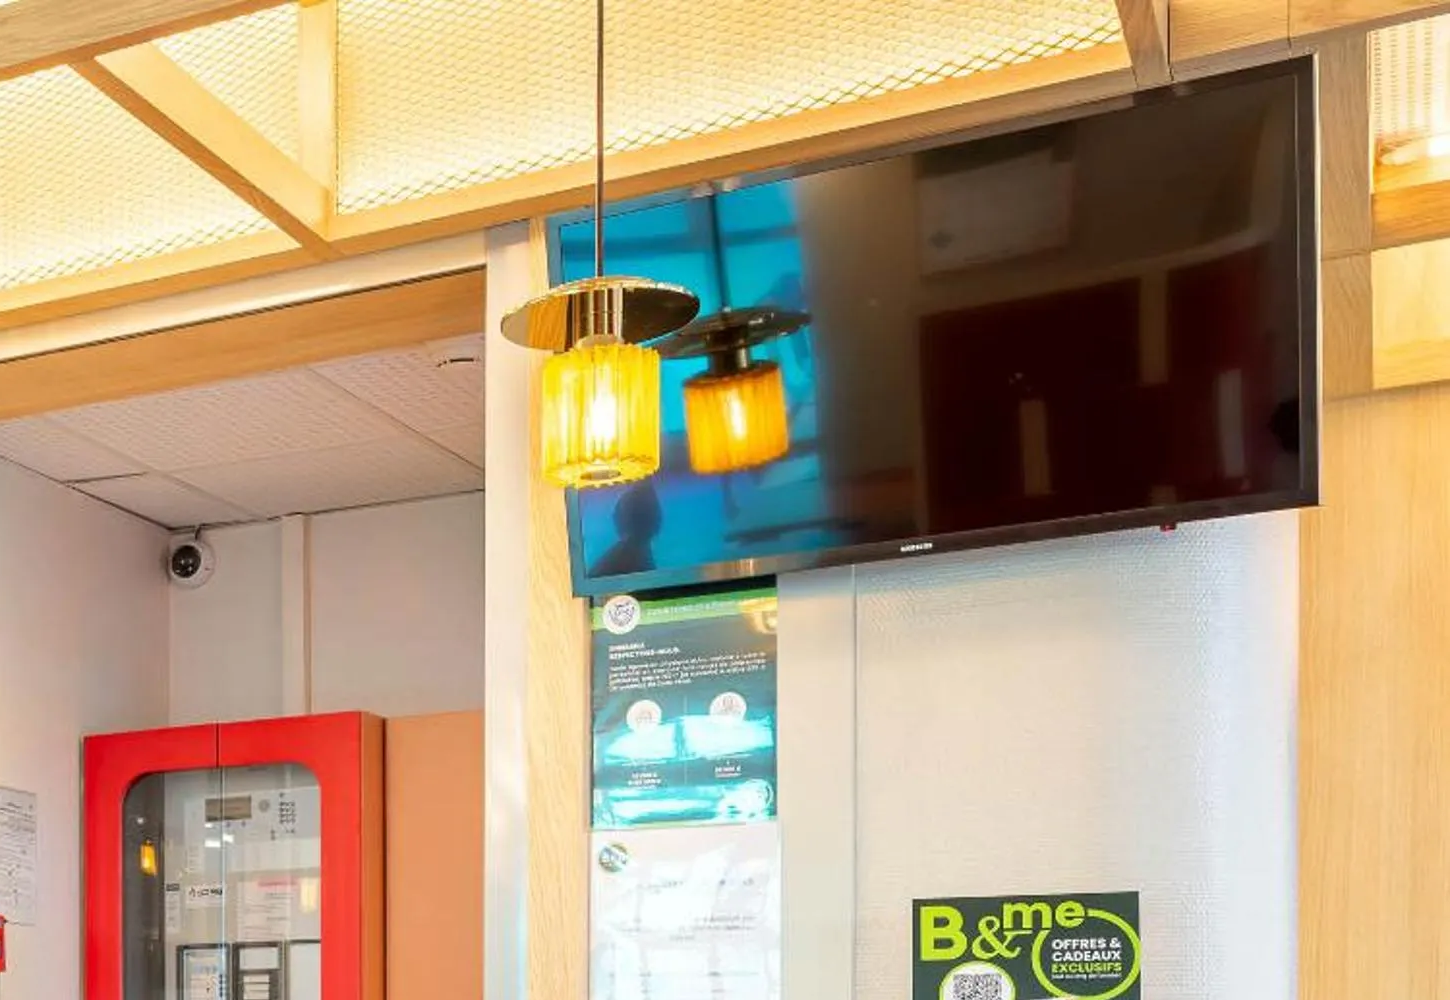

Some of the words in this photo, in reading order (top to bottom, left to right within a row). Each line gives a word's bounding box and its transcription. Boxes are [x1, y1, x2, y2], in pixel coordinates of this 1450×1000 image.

[1051, 938, 1107, 950] OFFRES
[1109, 937, 1121, 949] &
[1052, 950, 1121, 962] CADEAUX
[1051, 961, 1123, 973] EXCLUSIFS
